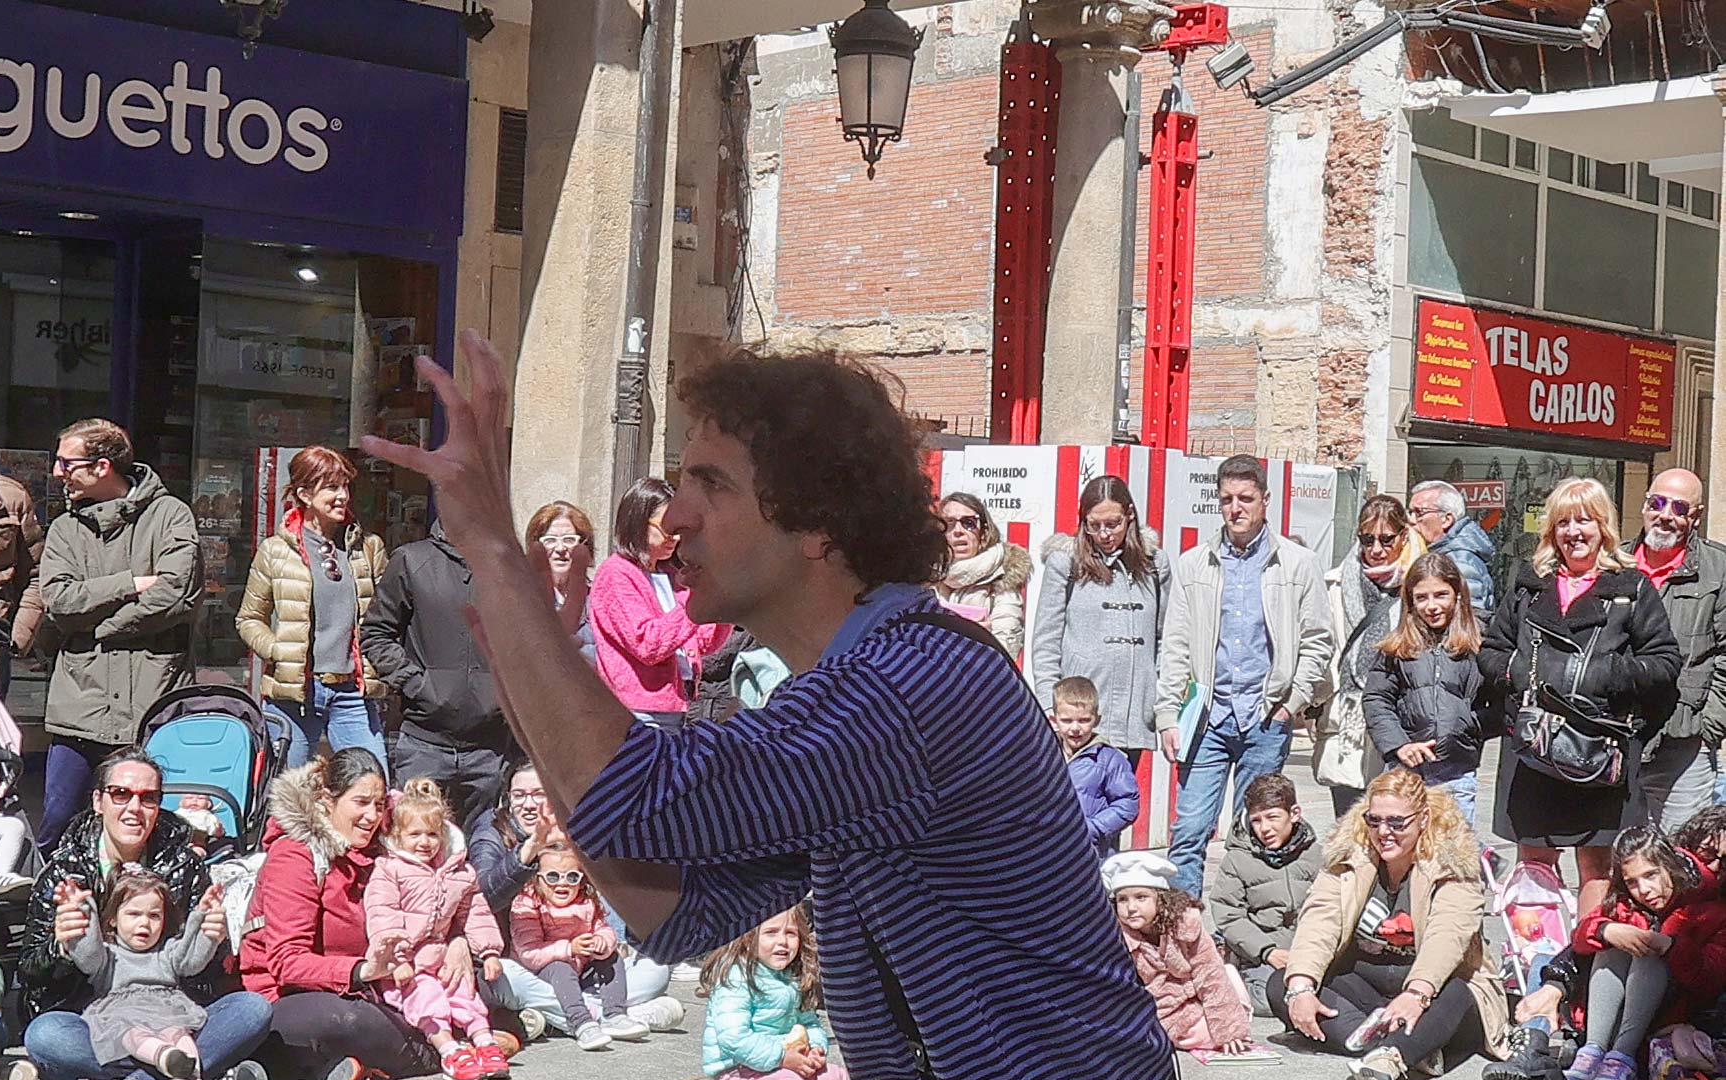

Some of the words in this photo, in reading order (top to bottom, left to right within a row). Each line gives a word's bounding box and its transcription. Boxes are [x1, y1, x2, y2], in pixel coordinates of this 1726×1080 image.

[1485, 326, 1569, 376] TELAS
[1529, 378, 1615, 426] CARLOS
[973, 467, 1027, 478] PROHIBIDO
[986, 483, 1011, 496] FIJAR
[983, 498, 1021, 509] ARTELES
